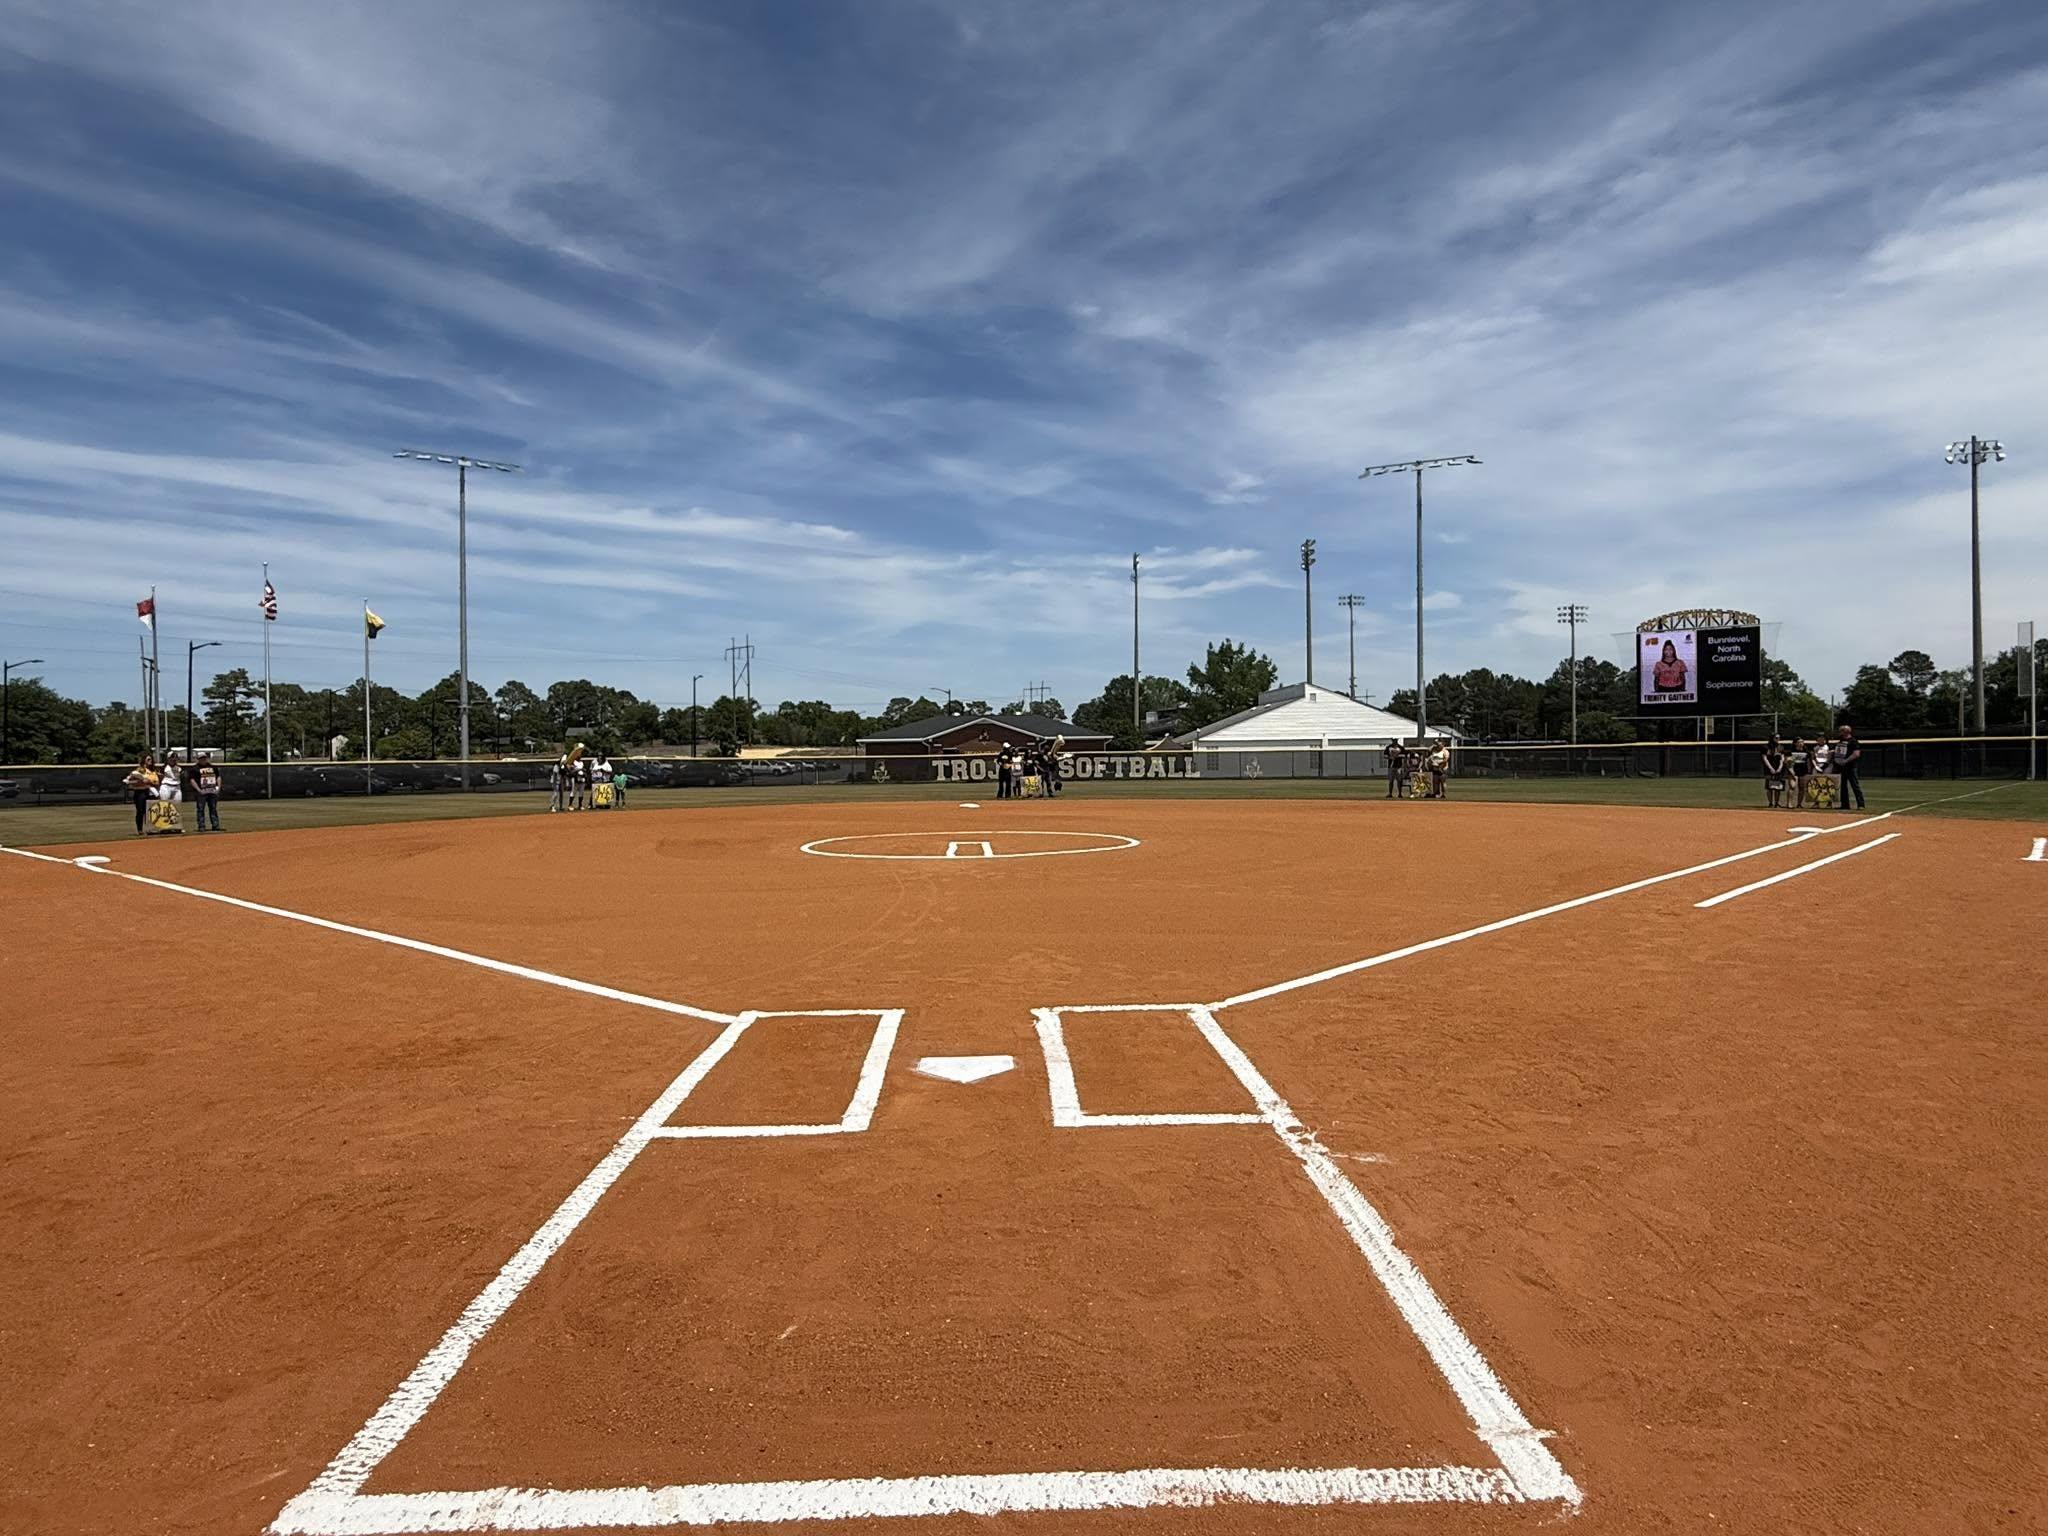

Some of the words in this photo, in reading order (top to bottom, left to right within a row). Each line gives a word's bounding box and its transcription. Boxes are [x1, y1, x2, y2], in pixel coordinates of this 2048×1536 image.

[1711, 654, 1746, 662] Carolina
[1706, 681, 1753, 689] Sophomore
[931, 759, 1001, 781] TROJ
[1058, 756, 1200, 778] SOFTBALL
